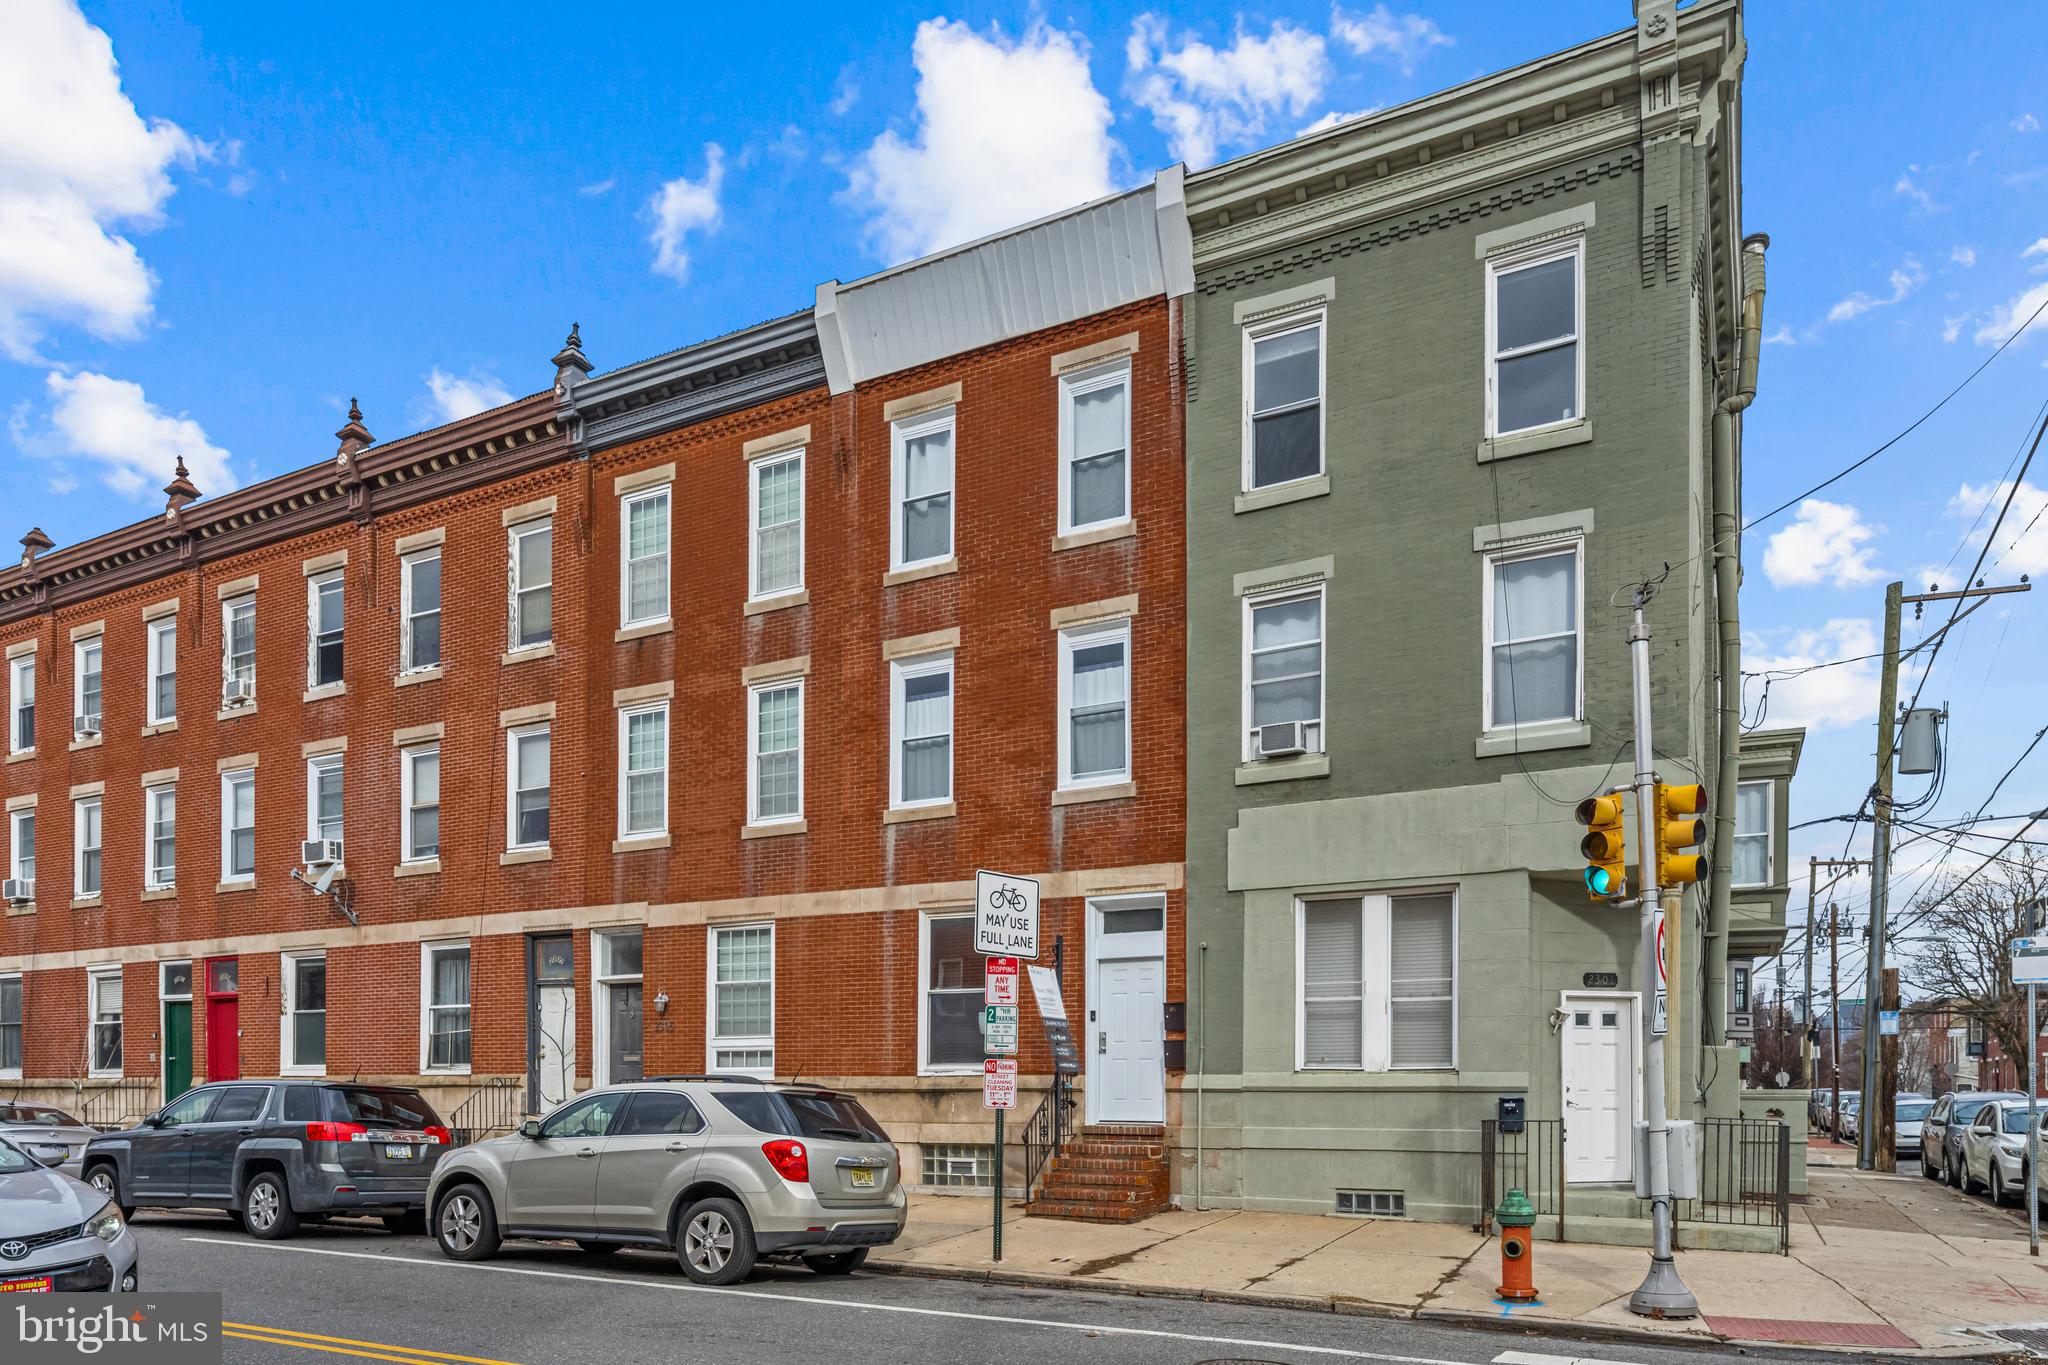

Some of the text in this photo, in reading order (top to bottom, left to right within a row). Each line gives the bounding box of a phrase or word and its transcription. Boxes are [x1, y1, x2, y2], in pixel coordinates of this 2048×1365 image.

[986, 913, 1029, 931] MAY USE
[981, 930, 1033, 949] FULL LANE
[998, 958, 1007, 966] NO
[989, 965, 1016, 973] STOPPING
[995, 976, 1009, 984] ANY
[995, 985, 1010, 993] TIME
[988, 1008, 995, 1021] 2
[986, 1061, 1015, 1072] NO PARKING
[16, 1280, 48, 1290] FINDERS
